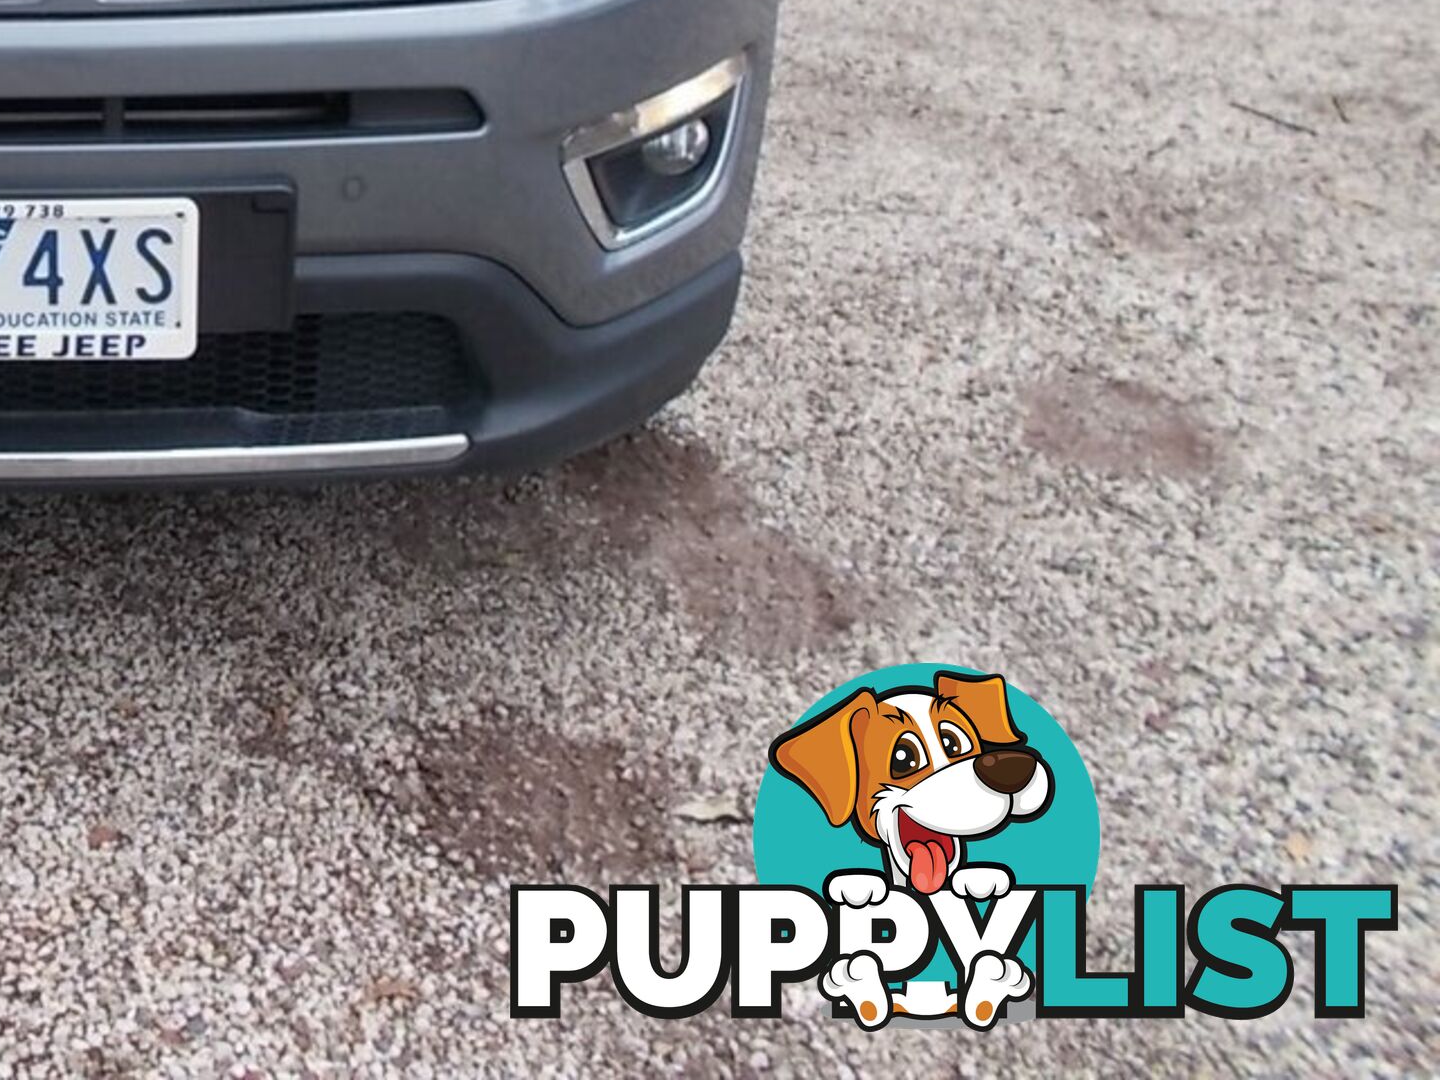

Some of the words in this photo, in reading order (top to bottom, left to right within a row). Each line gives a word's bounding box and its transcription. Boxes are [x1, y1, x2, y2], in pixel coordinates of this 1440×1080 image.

[26, 204, 65, 219] 738
[22, 229, 173, 306] 4XS
[105, 310, 166, 328] STATE
[51, 334, 147, 357] JEEP
